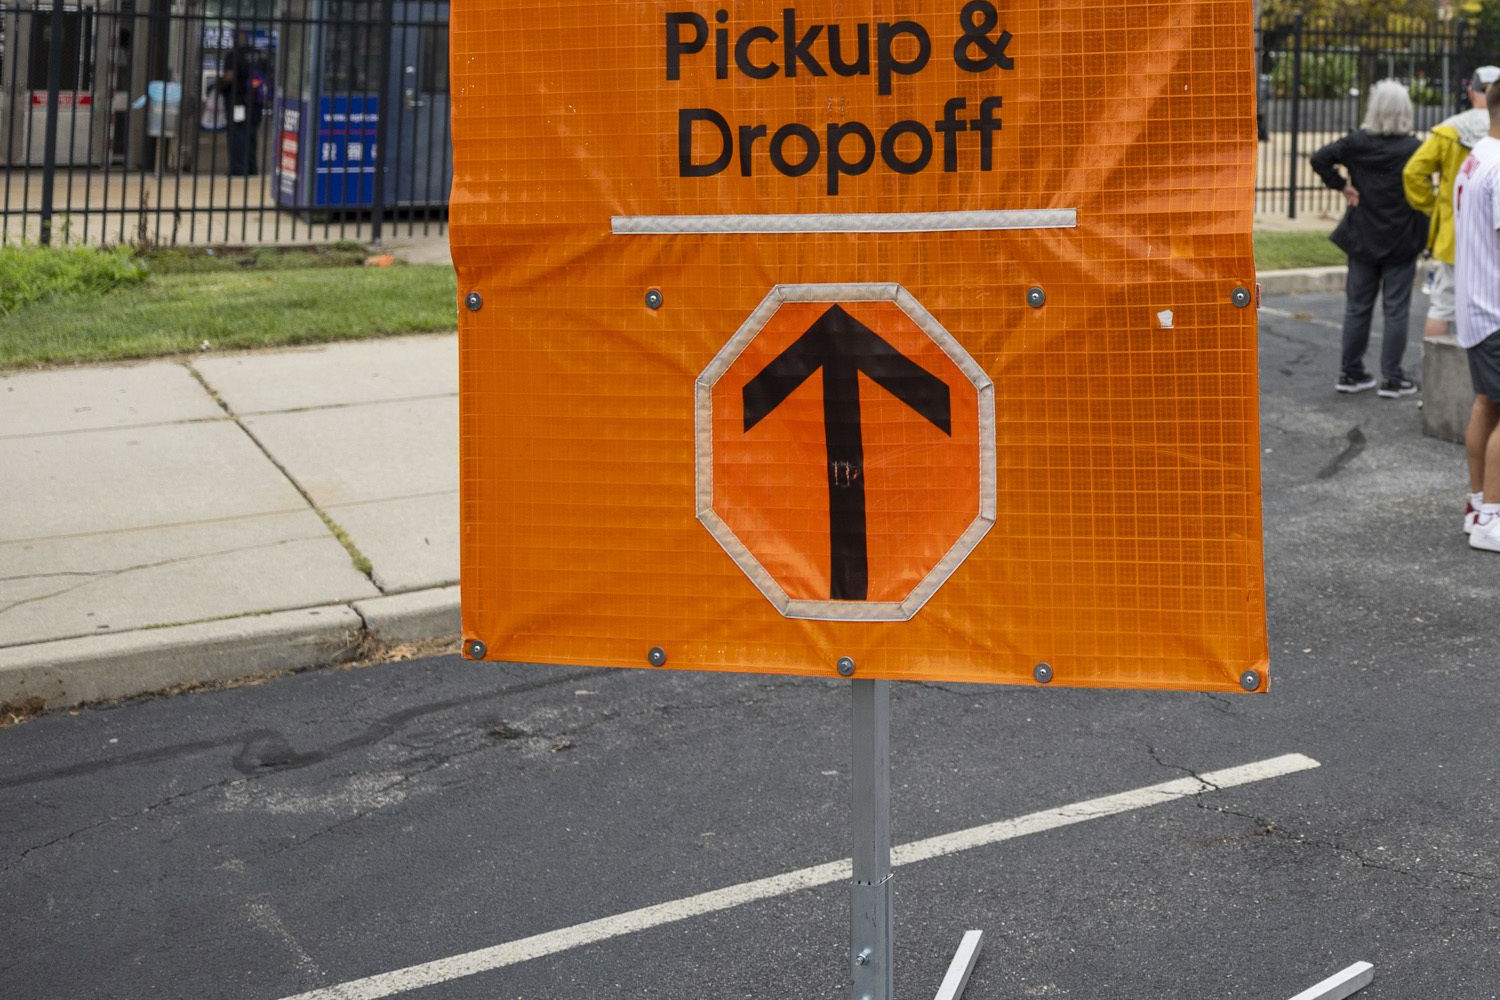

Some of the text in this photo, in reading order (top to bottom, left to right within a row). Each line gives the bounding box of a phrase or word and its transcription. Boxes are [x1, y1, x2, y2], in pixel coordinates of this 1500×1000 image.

[665, 0, 1014, 96] Pickup &
[678, 96, 1003, 196] Dropoff
